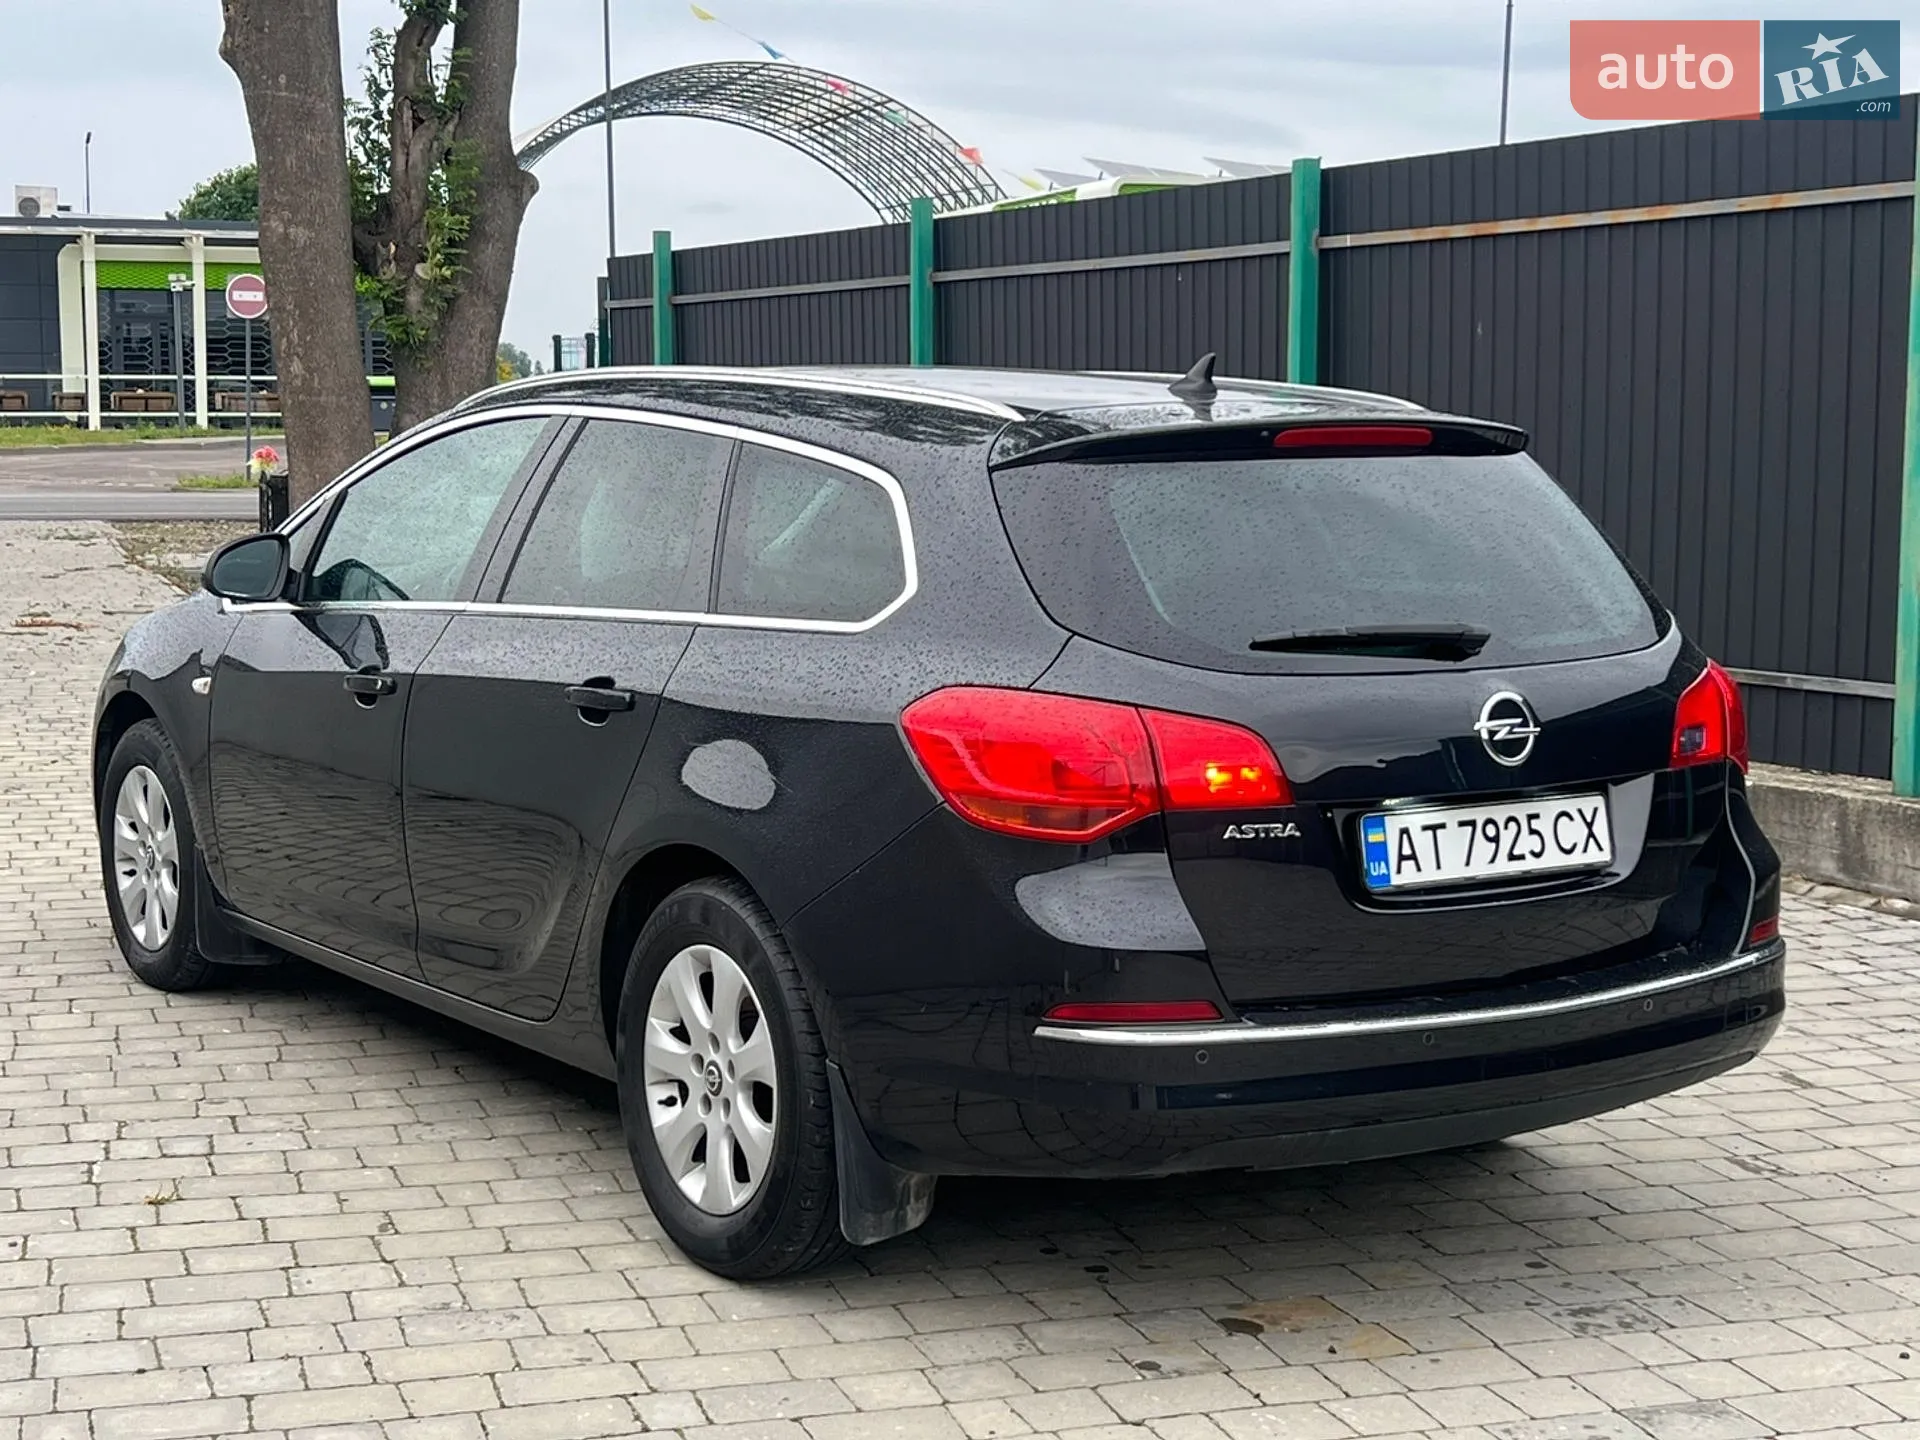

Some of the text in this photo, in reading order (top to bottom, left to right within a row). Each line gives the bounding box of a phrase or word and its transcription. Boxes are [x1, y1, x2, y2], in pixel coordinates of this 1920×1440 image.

[1222, 822, 1301, 839] ASTRA
[1396, 807, 1604, 875] AT 7925 CX
[1369, 861, 1388, 876] UA
